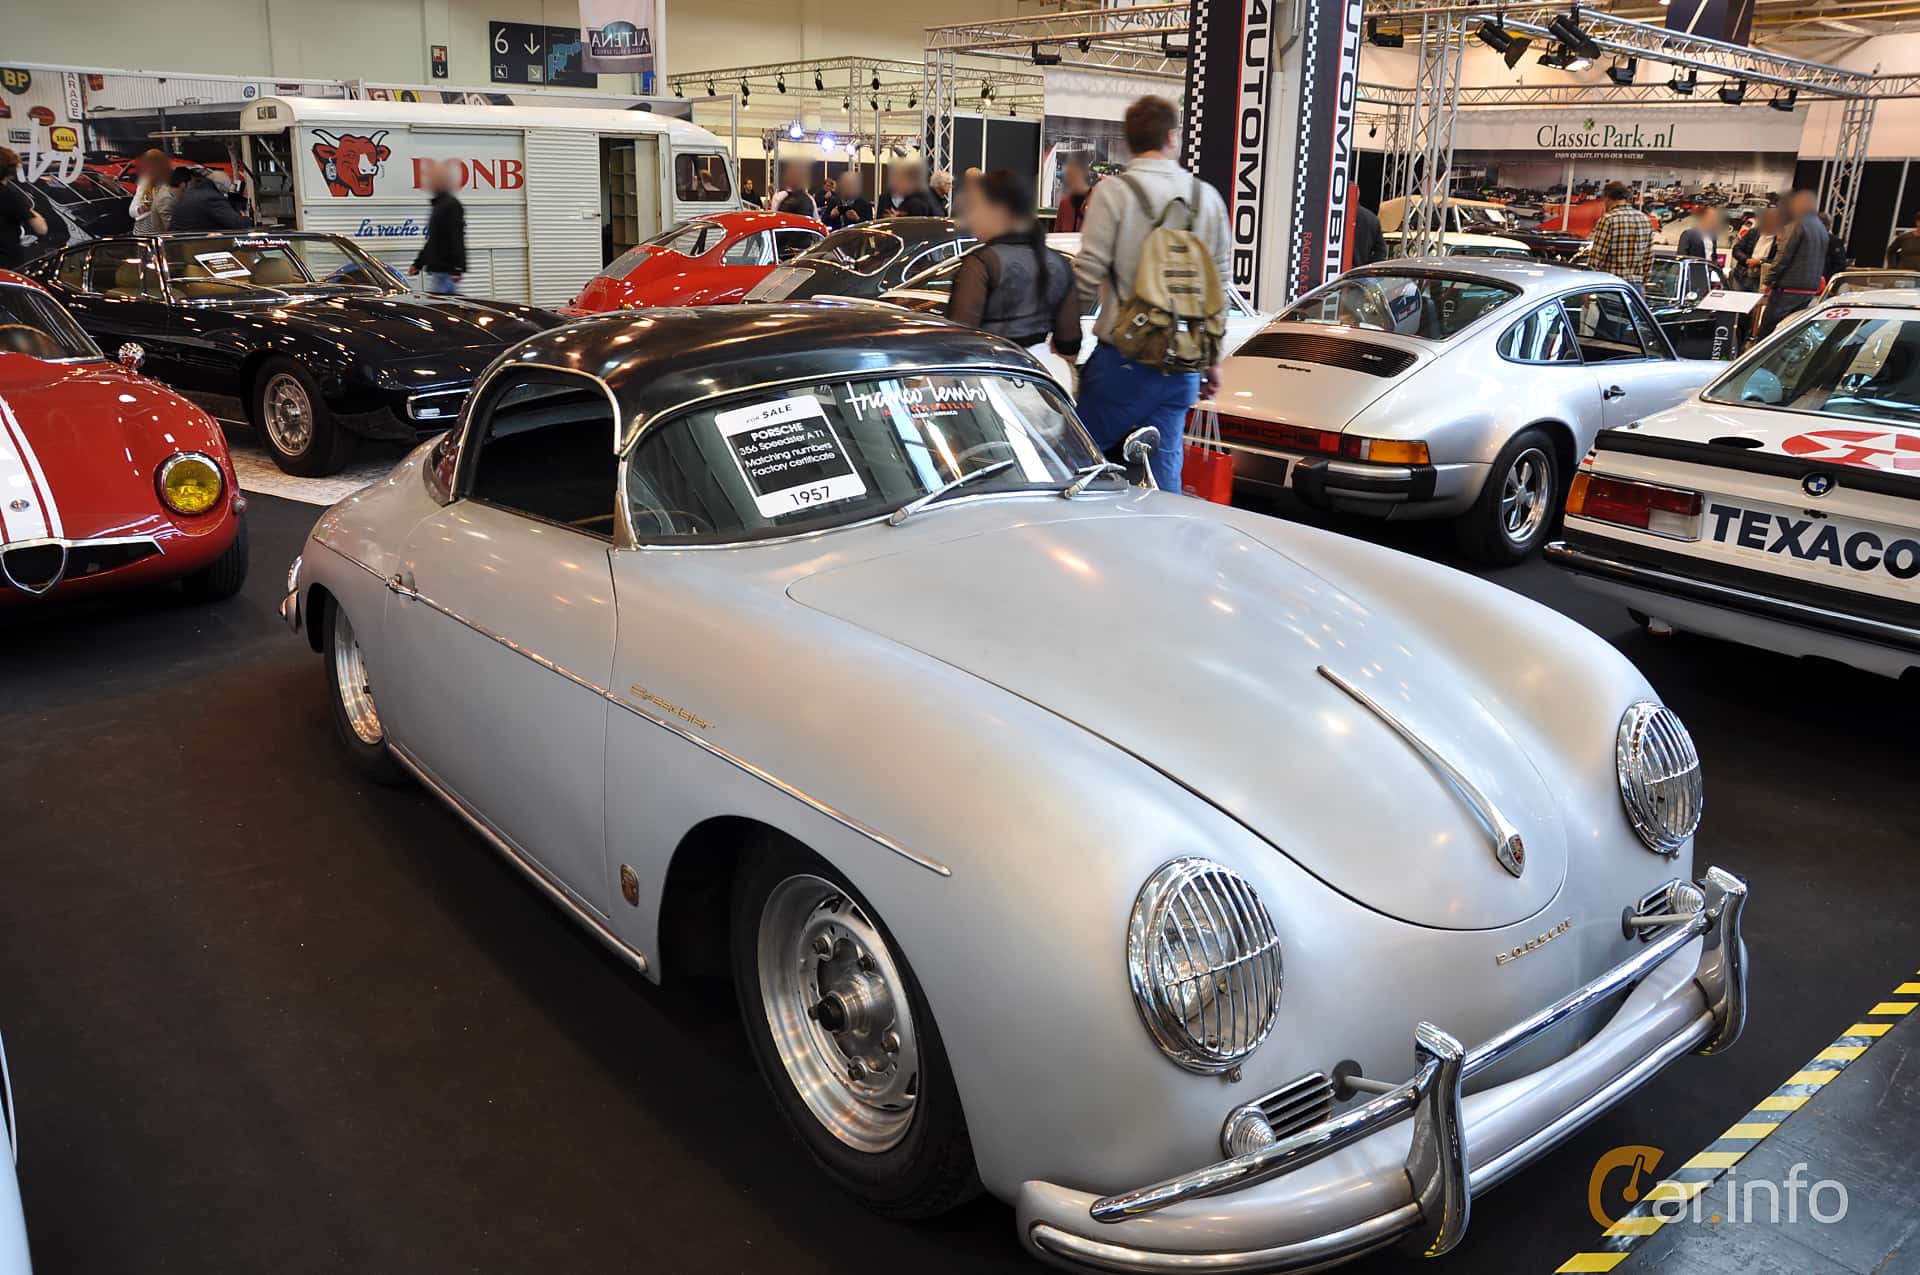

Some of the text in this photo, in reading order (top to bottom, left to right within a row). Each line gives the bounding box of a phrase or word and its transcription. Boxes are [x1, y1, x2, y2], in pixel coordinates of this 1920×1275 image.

[494, 27, 509, 54] 6
[3, 69, 29, 87] BP
[354, 219, 375, 237] La
[377, 219, 418, 237] vache
[1300, 231, 1313, 272] RACING
[762, 403, 793, 419] SALE
[738, 444, 759, 456] 356
[758, 433, 806, 452] Speedster
[807, 431, 814, 440] A
[750, 422, 805, 442] PORSCHE
[744, 441, 833, 469] Matching numbers
[751, 450, 836, 478] Factory certificate
[790, 485, 831, 506] 1957
[1710, 503, 1920, 579] TEXACO
